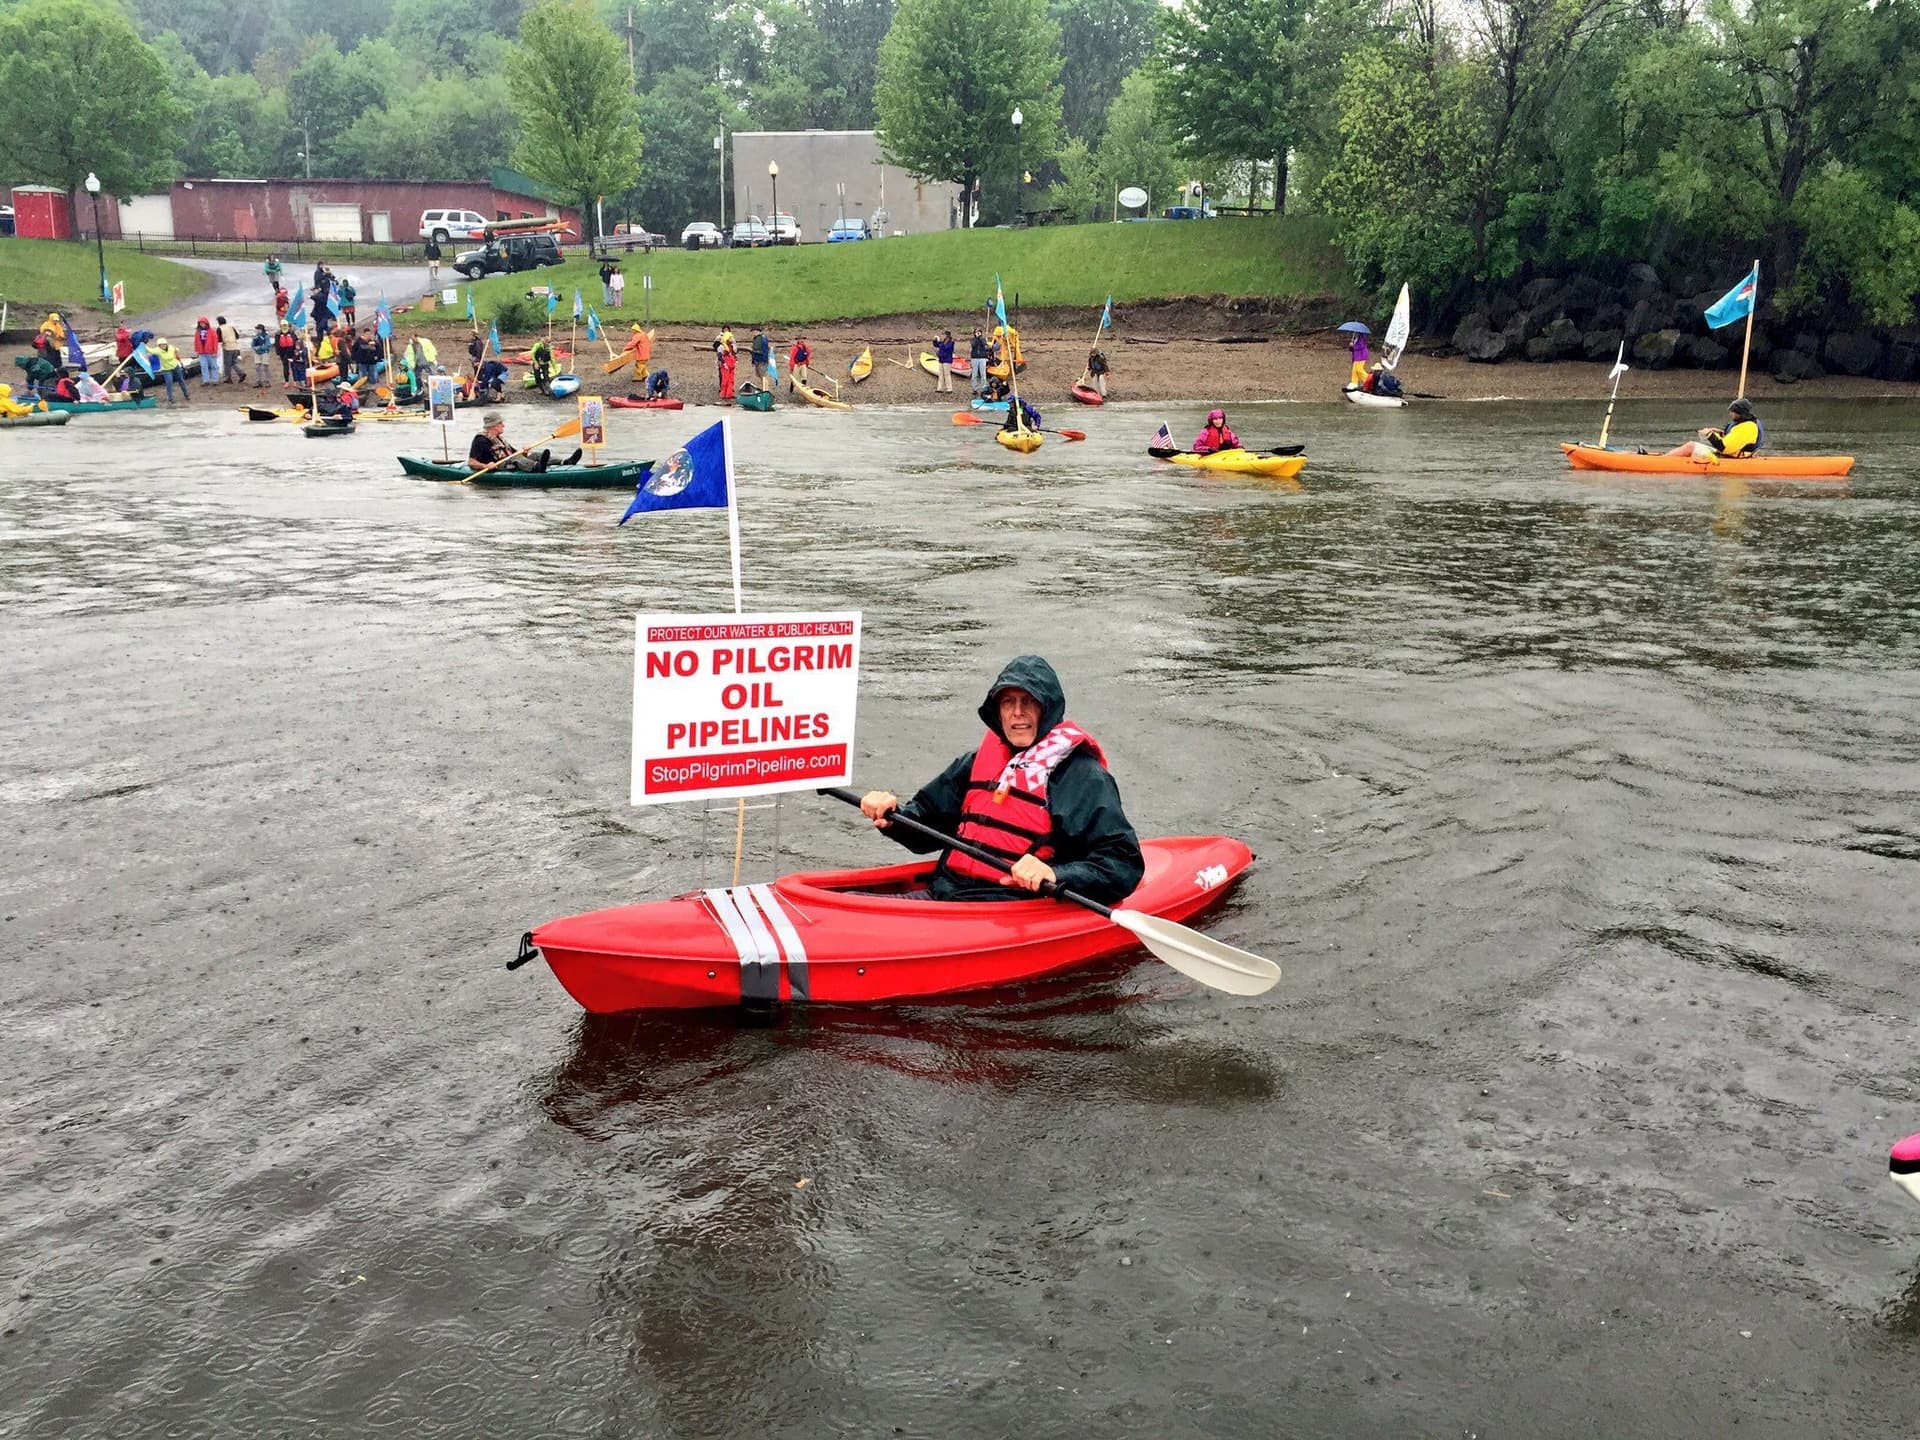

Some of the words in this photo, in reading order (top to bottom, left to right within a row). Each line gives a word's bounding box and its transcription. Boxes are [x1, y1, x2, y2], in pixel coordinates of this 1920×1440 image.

[650, 627, 701, 640] PROTECT
[704, 626, 727, 638] OUR
[730, 625, 765, 638] WATER
[768, 625, 775, 637] &
[777, 624, 813, 636] PUBLIC
[816, 623, 852, 635] HEALTH
[646, 650, 699, 678] NO
[712, 644, 852, 675] PILGRIM
[721, 683, 783, 710] OIL
[668, 713, 830, 749] PIPELINES
[652, 753, 841, 784] StopPilgrimPipeline.com
